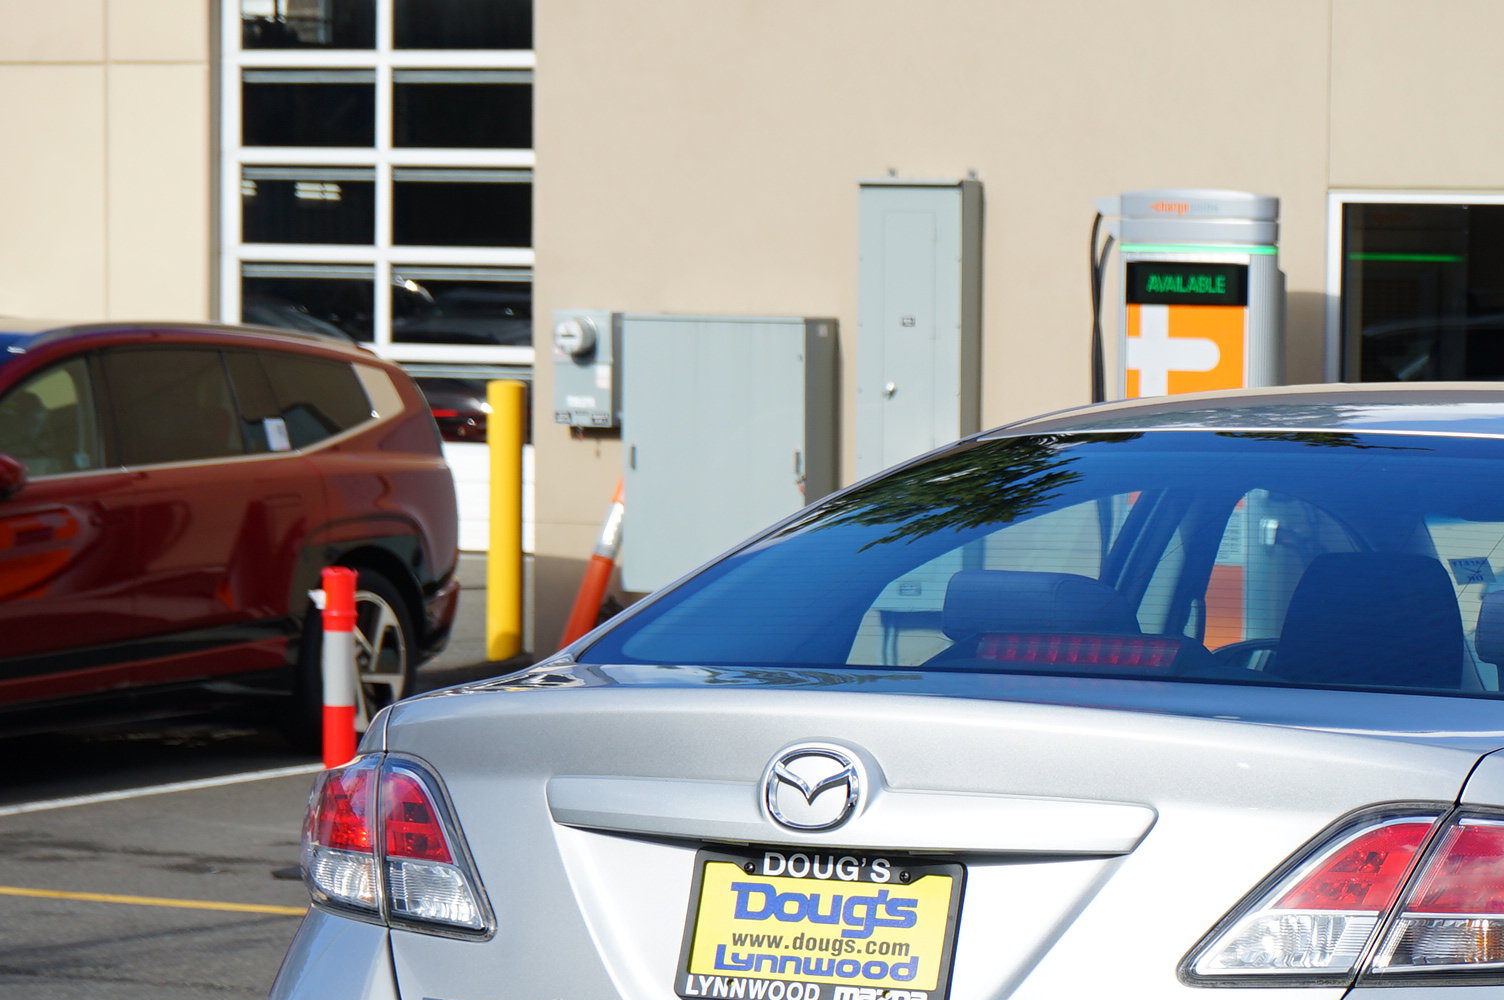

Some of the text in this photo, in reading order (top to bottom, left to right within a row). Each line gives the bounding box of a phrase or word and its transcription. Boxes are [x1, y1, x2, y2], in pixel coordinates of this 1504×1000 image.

[1146, 274, 1226, 294] AVAILABLE
[762, 851, 892, 883] DOUG'S
[730, 881, 919, 939] Doug's
[731, 932, 911, 957] www.dougs.com
[713, 944, 919, 982] Lynnwood
